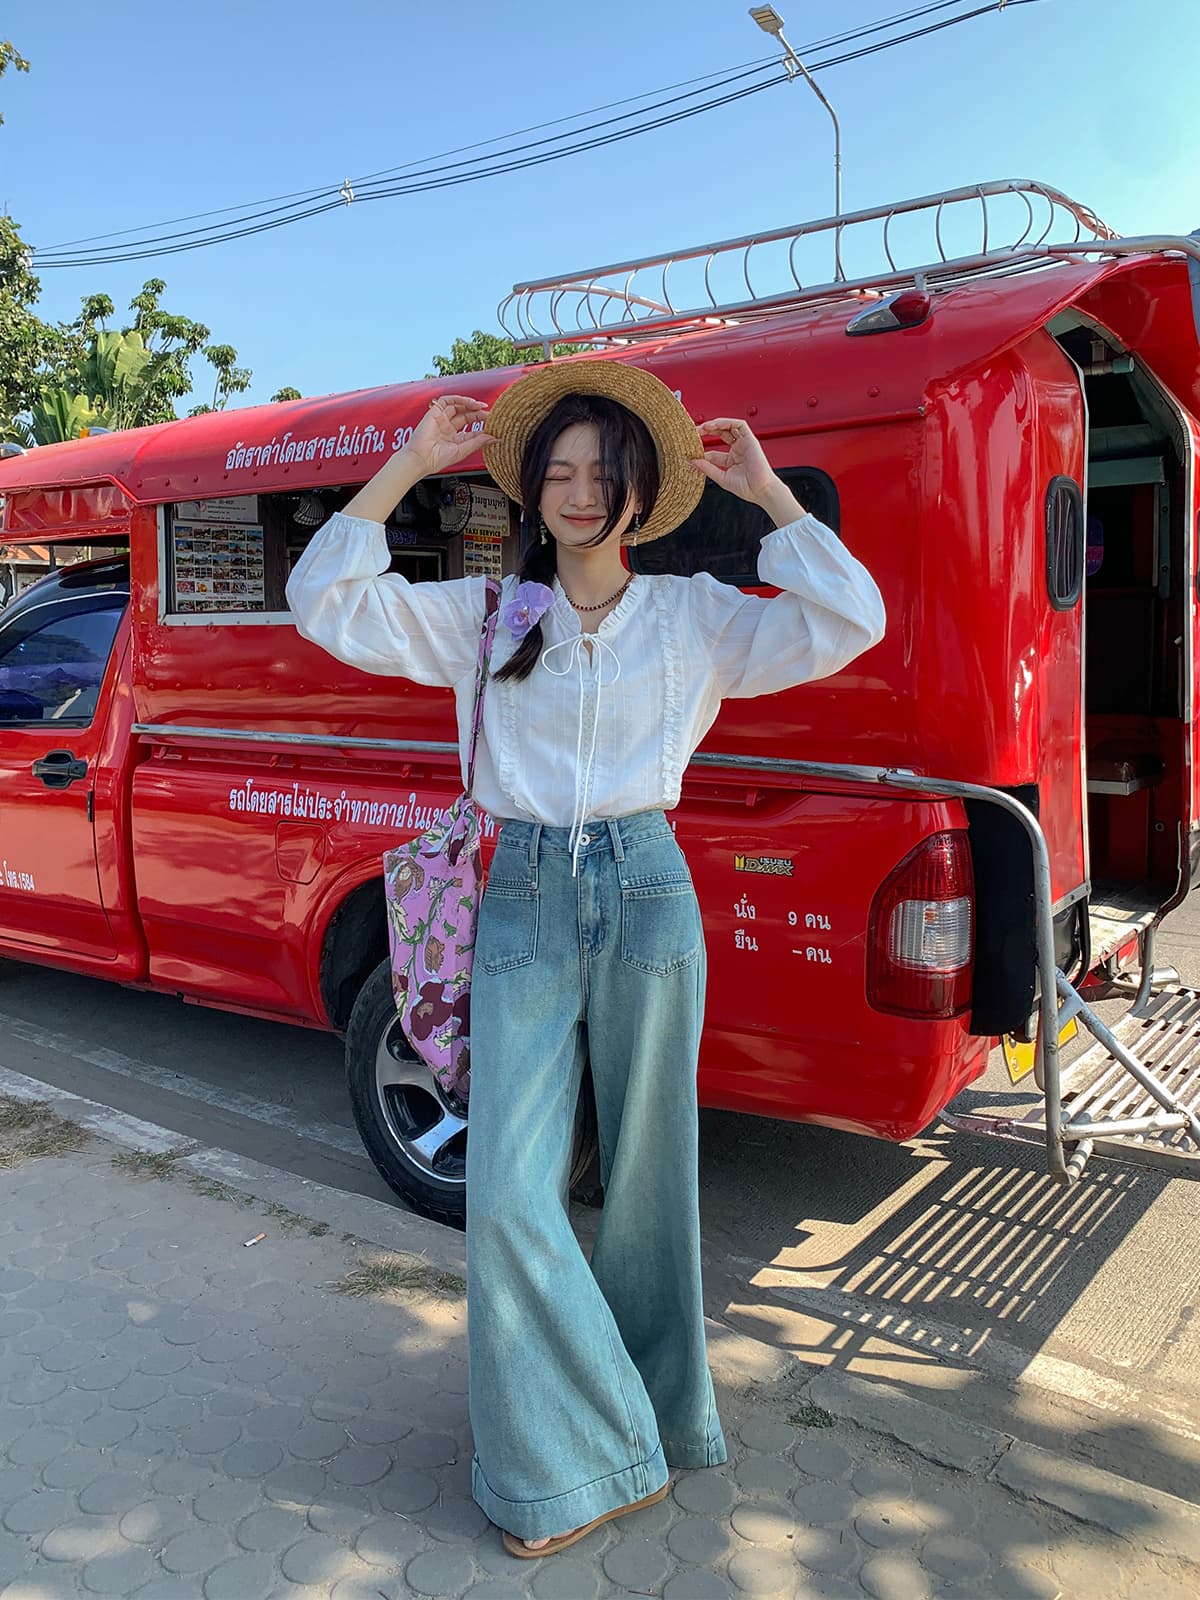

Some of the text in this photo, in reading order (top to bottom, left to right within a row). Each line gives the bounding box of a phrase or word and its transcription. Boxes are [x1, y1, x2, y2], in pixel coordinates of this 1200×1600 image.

[225, 424, 386, 470] อัตราค่าโดยสารไม่เกิน
[479, 529, 501, 537] SERVICE
[229, 778, 444, 830] รถโดยสารไม่ประจำทางภายในเข
[760, 857, 791, 866] ISUZU
[733, 892, 832, 930] นั่ง 9 คน
[734, 928, 759, 952] ยืน
[805, 946, 833, 964] คน
